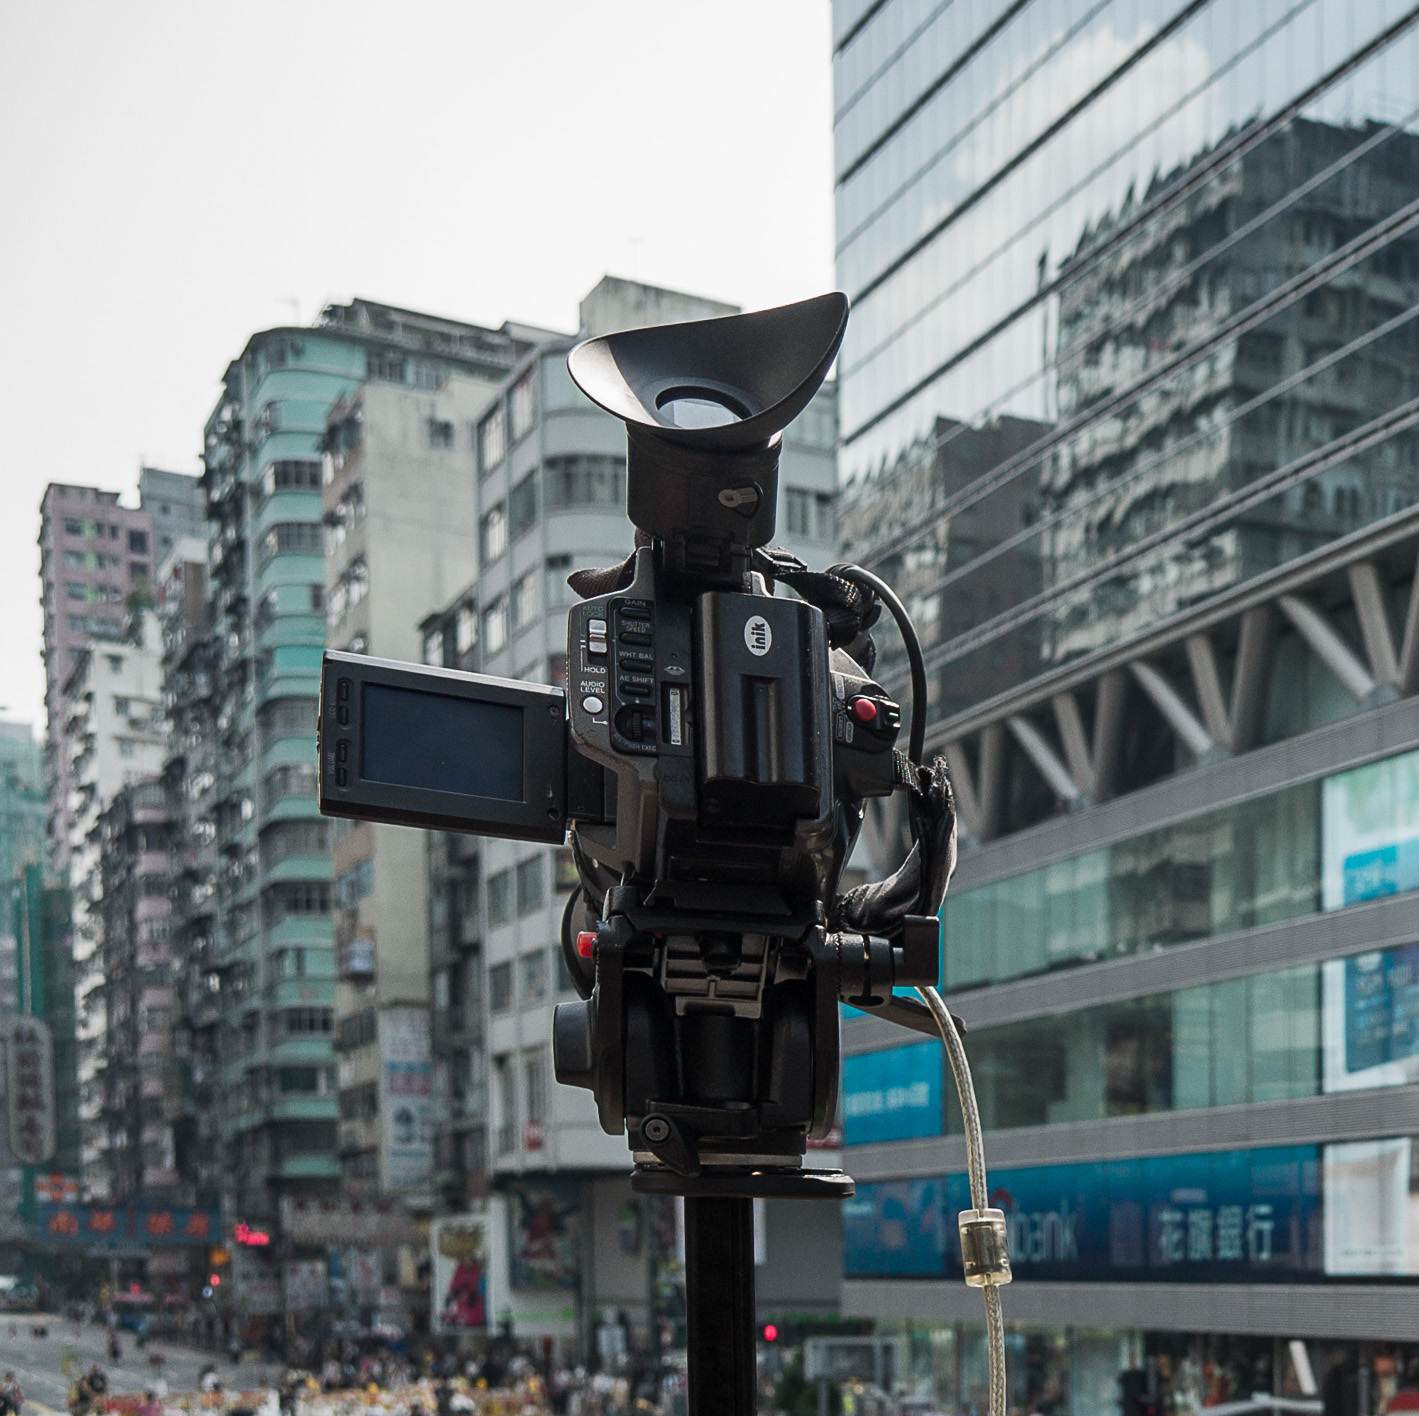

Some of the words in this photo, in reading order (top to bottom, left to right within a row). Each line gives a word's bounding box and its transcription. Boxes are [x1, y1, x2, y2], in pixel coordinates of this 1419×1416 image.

[751, 622, 767, 650] inik
[584, 666, 606, 674] HOLD
[580, 680, 605, 688] AUDIO
